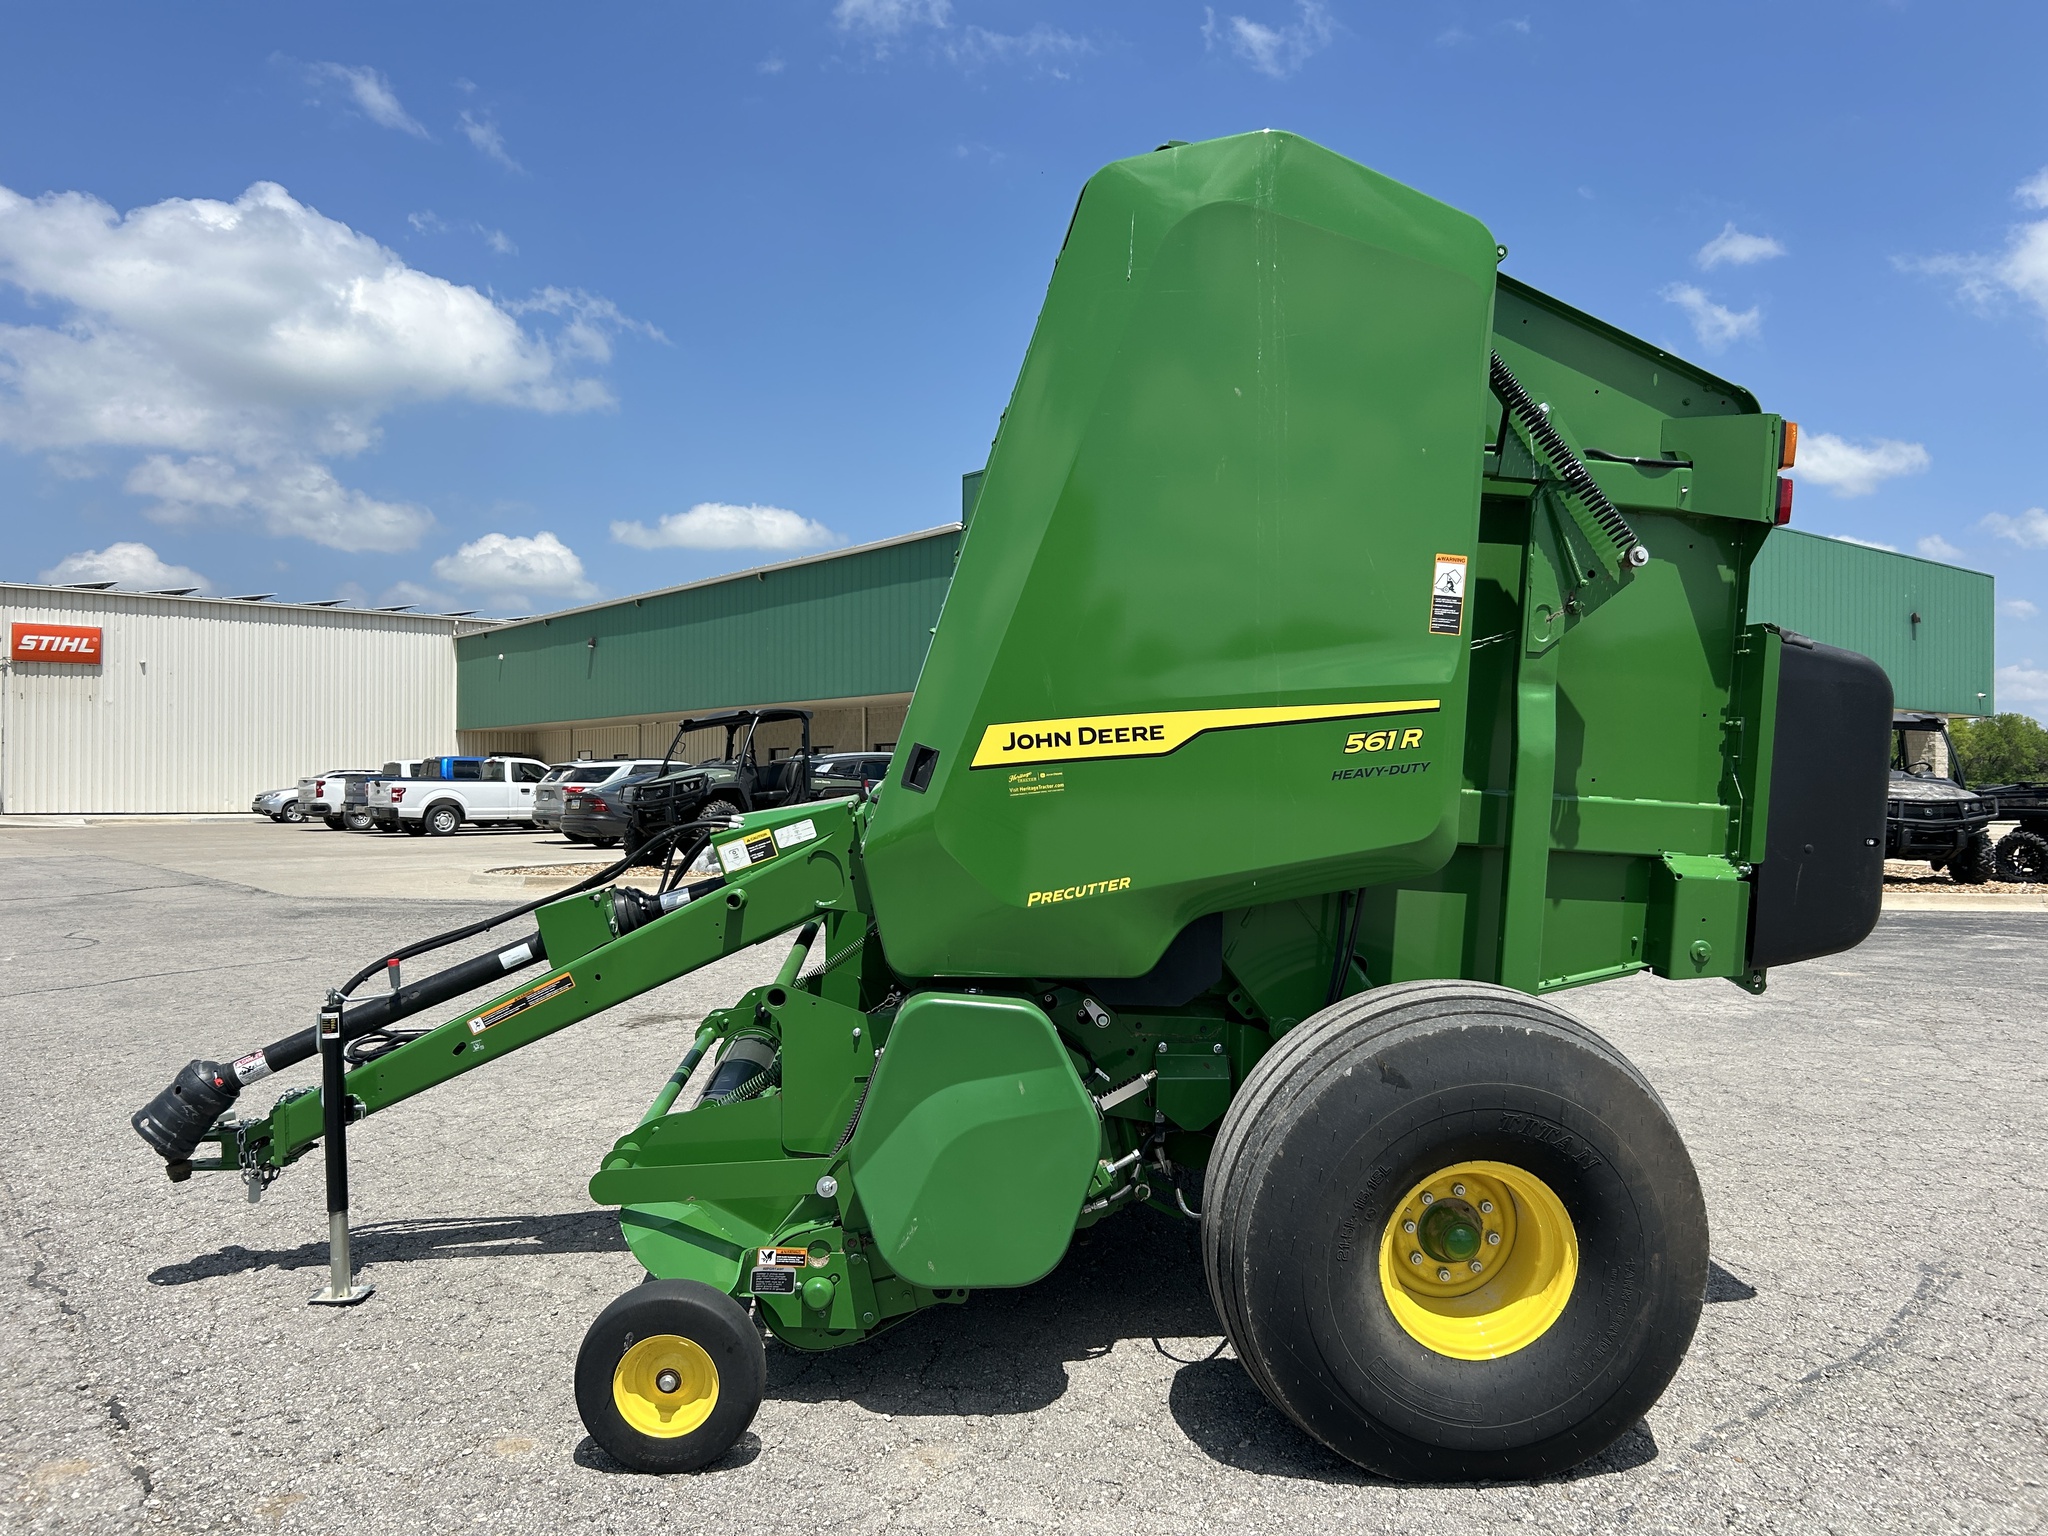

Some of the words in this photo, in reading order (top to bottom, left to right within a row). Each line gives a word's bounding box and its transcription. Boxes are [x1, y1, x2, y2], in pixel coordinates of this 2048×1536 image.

[1440, 556, 1466, 564] WARNING
[18, 634, 95, 653] STIHL
[1002, 732, 1071, 751] JOHN
[1078, 725, 1165, 746] DEERE
[1343, 729, 1399, 754] 561
[1399, 727, 1424, 750] R
[1331, 762, 1431, 781] HEAVY-DUTY
[750, 832, 768, 842] CAUTION
[1027, 877, 1131, 907] PRECUTTER
[1498, 1111, 1602, 1170] TITAN
